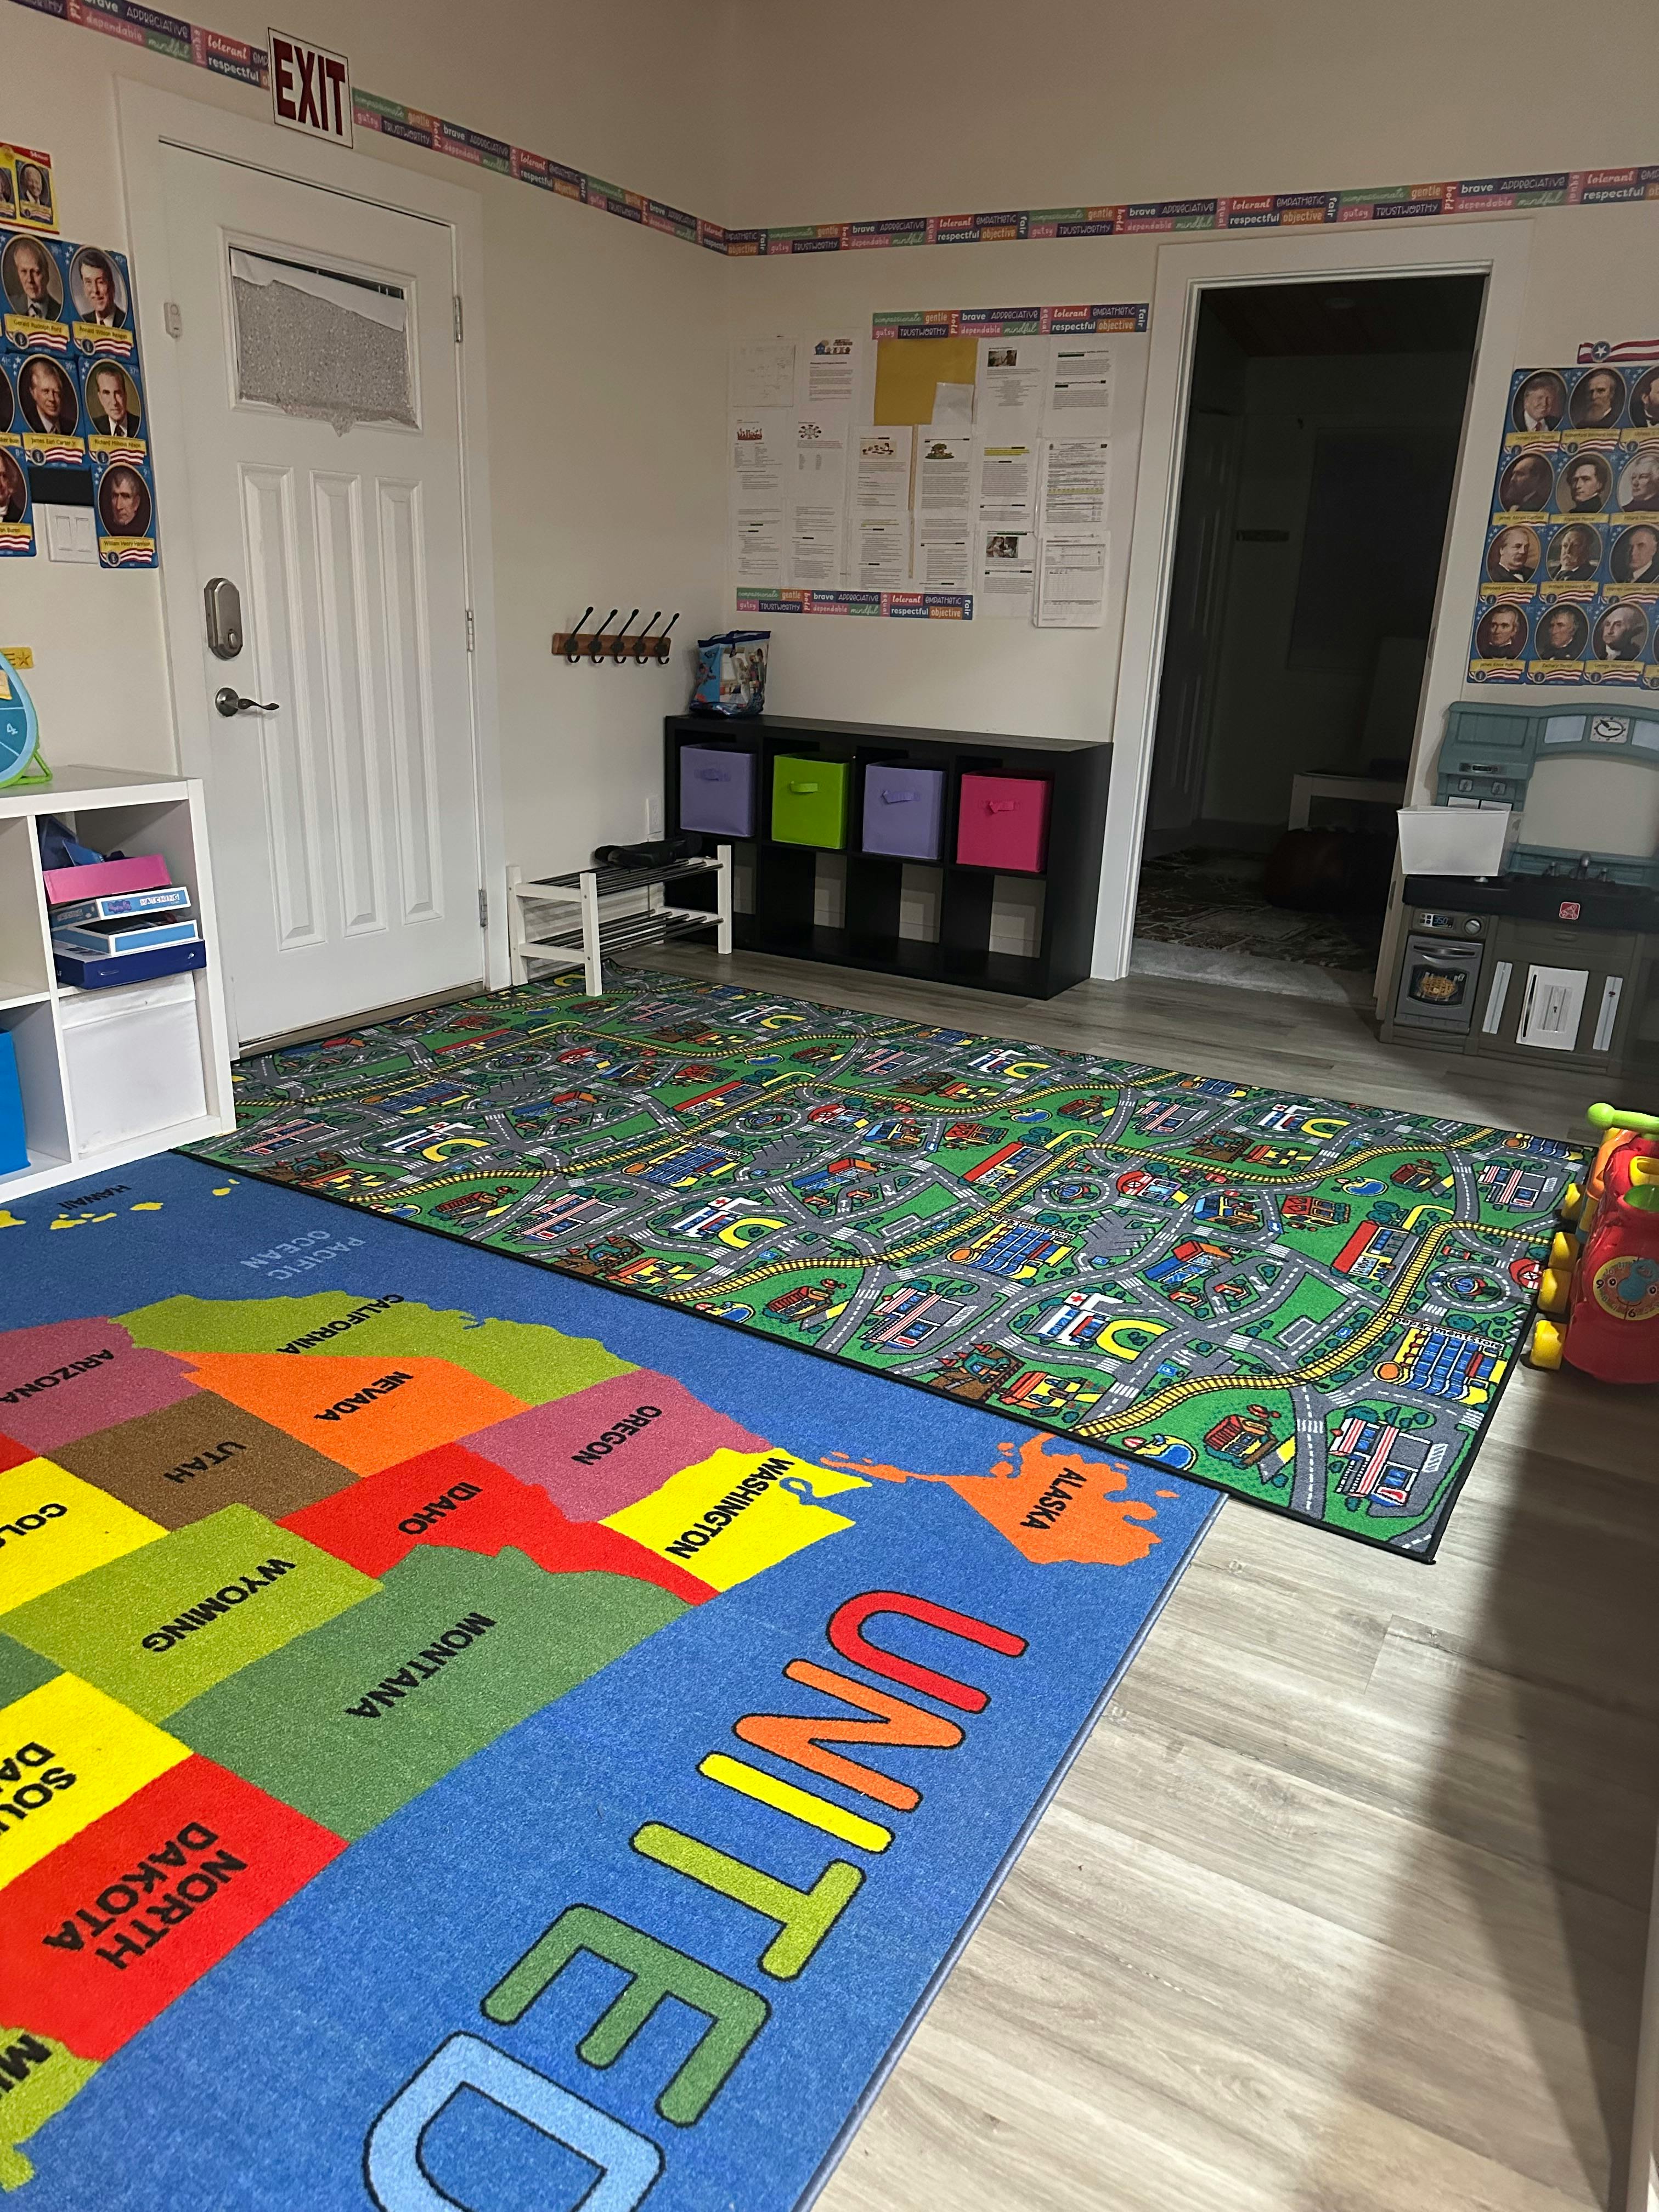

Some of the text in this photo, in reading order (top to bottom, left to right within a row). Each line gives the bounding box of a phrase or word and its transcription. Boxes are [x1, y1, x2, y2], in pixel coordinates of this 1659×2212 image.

[208, 35, 247, 59] tolerant
[208, 55, 259, 82] respectful
[273, 37, 345, 137] EXIT
[443, 124, 466, 141] brave
[521, 153, 546, 170] tolerant
[521, 170, 554, 187] respectful
[1500, 176, 1565, 190] APPRECIATIVE
[1587, 170, 1634, 184] tolerant
[1411, 185, 1441, 200] gentle
[1461, 183, 1494, 194] brave
[1583, 186, 1645, 201] respectful
[1277, 195, 1325, 207] EMPATHETIC
[1444, 185, 1456, 210] bold
[1518, 191, 1564, 206] mindful
[1161, 204, 1215, 215] APPRECIATIVE
[1233, 199, 1271, 210] tolerant
[1327, 196, 1338, 217] fair
[1376, 202, 1439, 216] TRUSTWORTHY
[1458, 198, 1513, 211] dependable
[1088, 210, 1113, 220] gentle
[1129, 207, 1156, 217] brave
[1283, 209, 1323, 223] objective
[1343, 207, 1368, 221] gutsy
[939, 217, 972, 228] tolerant
[976, 215, 1017, 225] EMPATHETIC
[1019, 216, 1027, 234] fair
[1115, 208, 1125, 232] bold
[1230, 213, 1279, 225] respectful
[817, 227, 839, 238] gentle
[853, 225, 876, 234] brave
[880, 221, 925, 232] APPRECIATIVE
[1032, 227, 1053, 237] gutsy
[1059, 224, 1111, 235] TRUSTWORTHY
[1127, 221, 1172, 232] dependable
[937, 230, 980, 241] respectful
[982, 228, 1015, 239] objective
[794, 240, 838, 252] TRUSTWORTHY
[851, 235, 890, 248] dependable
[925, 311, 947, 323] gentle
[962, 313, 986, 321] brave
[991, 311, 1038, 320] APPRECIATIVE
[1053, 308, 1088, 317] tolerant
[1092, 307, 1135, 316] EMPATHETIC
[951, 313, 959, 334] bold
[961, 325, 1001, 334] dependable
[1004, 321, 1037, 334] mindful
[1052, 321, 1096, 331] respectful
[1098, 319, 1134, 330] objective
[875, 329, 895, 338] gutsy
[900, 326, 946, 337] TRUSTWORTHY
[781, 591, 802, 600] gentle
[814, 592, 834, 601] brave
[838, 594, 879, 602] APPRECIATIVE
[892, 595, 921, 603] tolerant
[925, 596, 962, 605] EMPATHETIC
[740, 601, 757, 610] gutsy
[760, 602, 800, 611] TRUSTWORTHY
[812, 604, 848, 614] dependable
[850, 603, 878, 616] mindful
[891, 607, 929, 617] respectful
[930, 608, 961, 618] objective
[7, 723, 18, 735] 4
[140, 893, 180, 905] MATCHING
[1434, 916, 1448, 925] 350
[59, 1184, 132, 1210] HAWAII
[239, 1230, 331, 1269] OCEAN
[267, 1236, 366, 1280] PACIFIC
[1596, 1279, 1604, 1289] 9
[1628, 1308, 1636, 1318] 6
[276, 1294, 404, 1355] CALIFORNIA
[0, 1348, 115, 1403] ARIZONA
[314, 1371, 414, 1422] NEVADA
[571, 1405, 663, 1465] OREGON
[164, 1441, 247, 1483] UTAH
[1019, 1467, 1088, 1531] ALASKA
[398, 1481, 483, 1535] IDAHO
[664, 1457, 795, 1560] WASHINGTON
[142, 1558, 296, 1653] WYOMING
[346, 1612, 498, 1721] MONTANA
[42, 1821, 218, 1953] DAKOTA
[363, 1589, 1030, 2212] UNITED
[95, 1849, 249, 1970] NORTH
